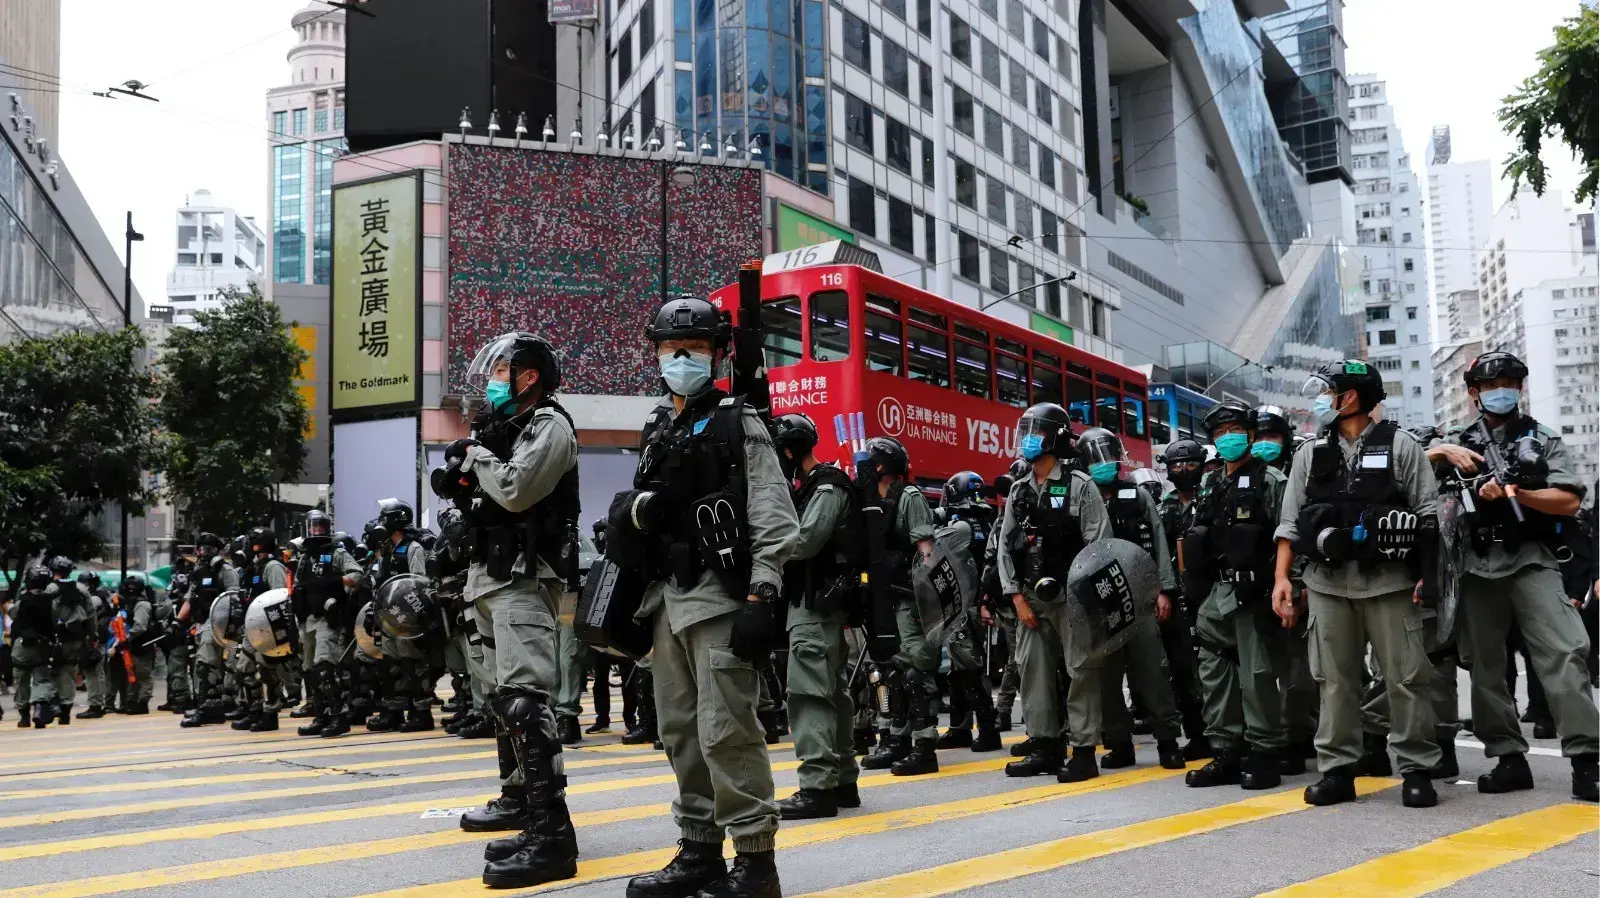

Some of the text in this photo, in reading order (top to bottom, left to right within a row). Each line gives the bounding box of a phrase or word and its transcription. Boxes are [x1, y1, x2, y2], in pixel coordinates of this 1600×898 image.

[782, 246, 820, 269] 116
[358, 198, 390, 357] 黃金廣場
[820, 272, 843, 286] 116
[338, 374, 409, 391] The Goldmark
[772, 391, 828, 409] FINANCE
[906, 404, 957, 429] 亞洲聯合財務
[907, 422, 958, 446] UA FINANCE
[966, 417, 1020, 459] YES,U
[941, 560, 961, 613] POLICE
[1108, 564, 1134, 623] POLICE
[403, 591, 424, 613] POLICE
